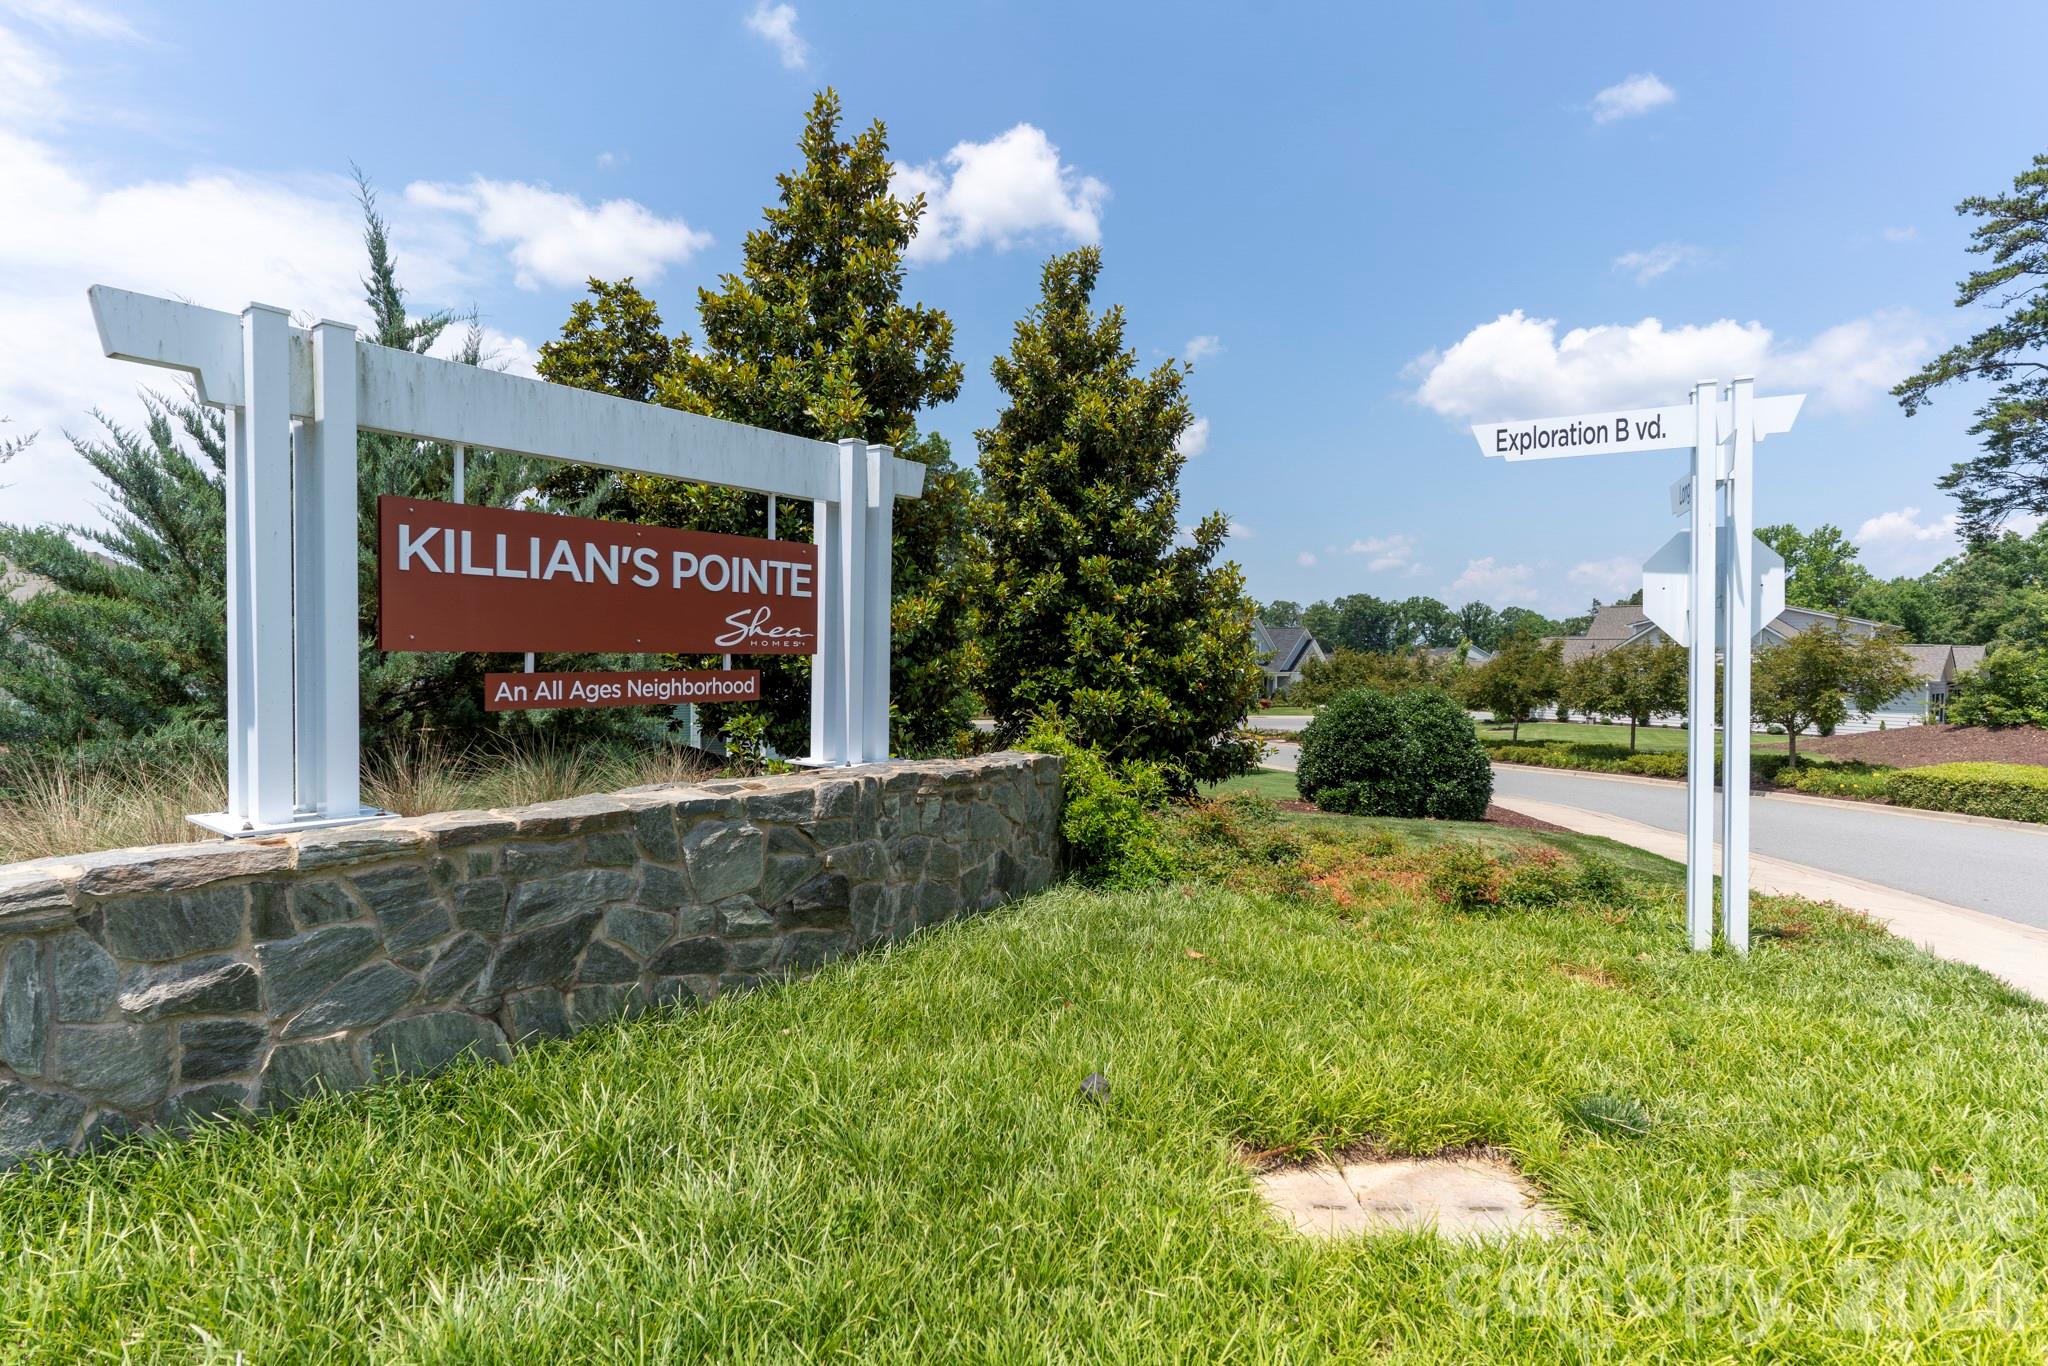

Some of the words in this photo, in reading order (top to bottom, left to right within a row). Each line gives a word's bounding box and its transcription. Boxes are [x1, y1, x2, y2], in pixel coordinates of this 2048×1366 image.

[1496, 420, 1608, 455] Exploration
[398, 523, 660, 588] KILLIAN'S
[671, 551, 813, 598] POINTE
[714, 605, 814, 647] Shea
[494, 681, 528, 702] An
[534, 680, 563, 701] All
[569, 679, 622, 702] Ages
[627, 675, 756, 700] Neighborhood
